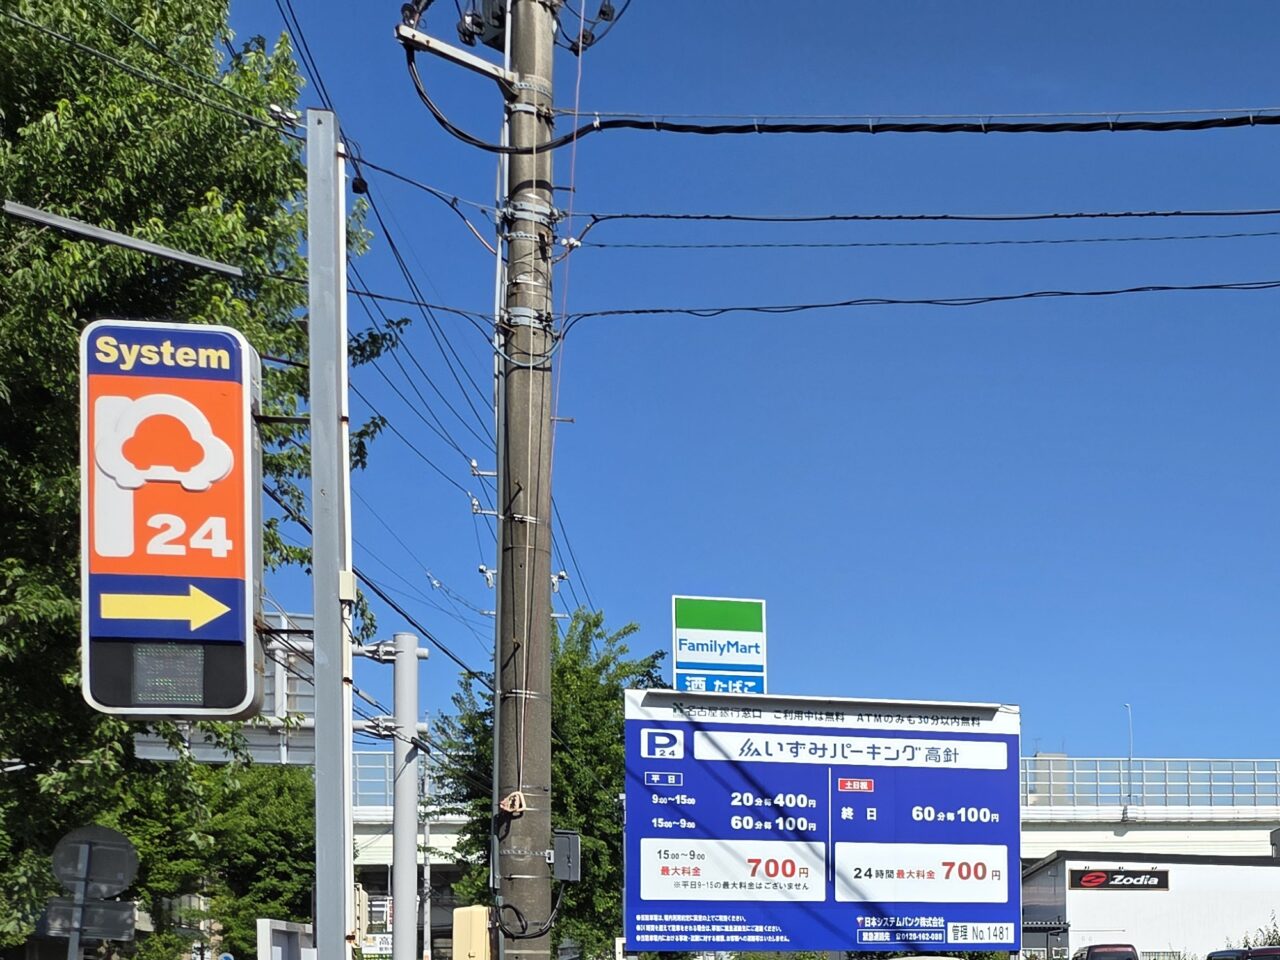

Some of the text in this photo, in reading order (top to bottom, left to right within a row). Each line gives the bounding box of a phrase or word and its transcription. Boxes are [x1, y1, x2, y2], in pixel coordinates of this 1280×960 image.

[95, 336, 230, 371] System
[146, 513, 233, 558] 24
[678, 638, 761, 656] FamilyMart
[841, 807, 877, 820] 終日
[661, 866, 701, 876] 最大料金
[1109, 875, 1159, 885] Zodia
